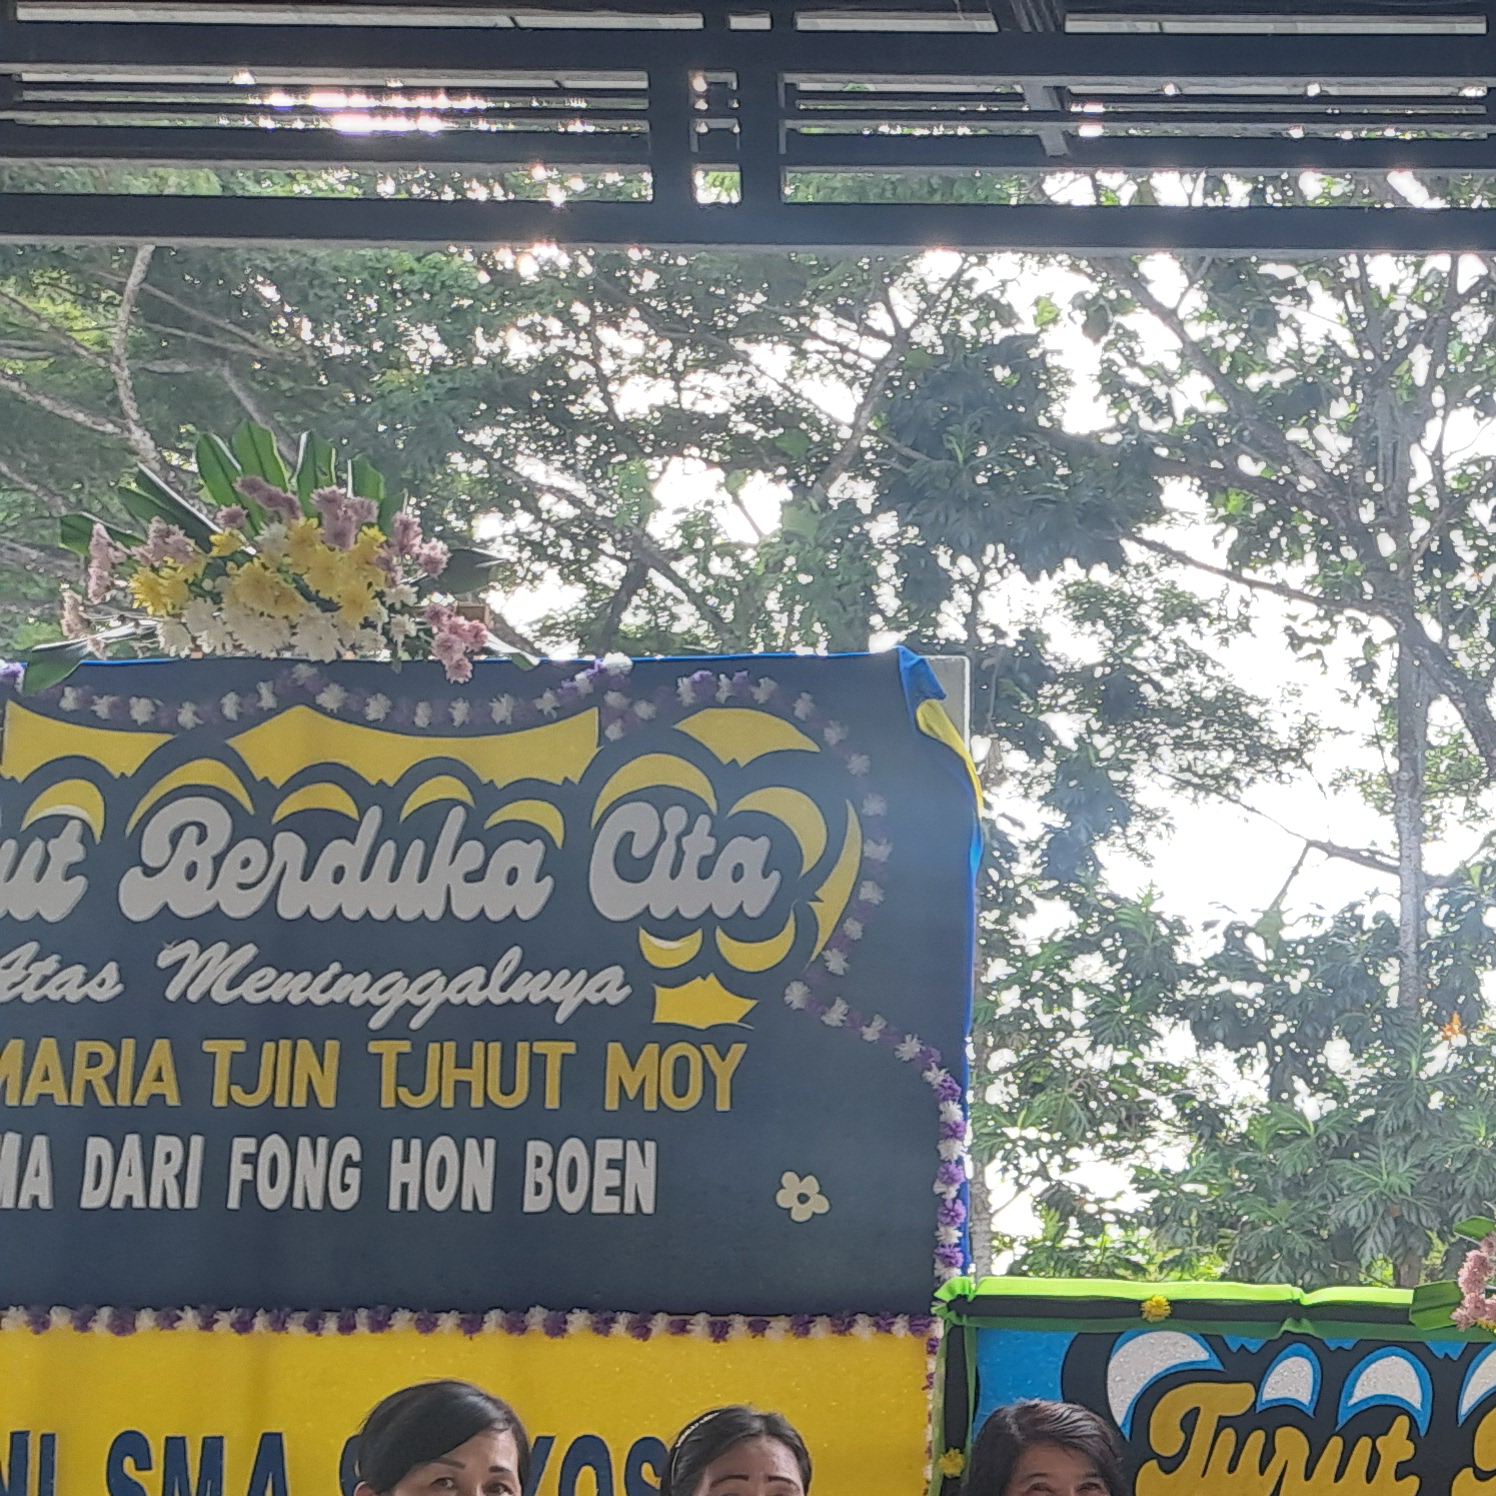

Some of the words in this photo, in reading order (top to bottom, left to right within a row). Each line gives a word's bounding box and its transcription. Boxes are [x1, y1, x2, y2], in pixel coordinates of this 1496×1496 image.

[118, 796, 554, 923] Berduka
[589, 802, 782, 922] Cita
[156, 939, 631, 1030] Meninggalnya
[202, 1038, 341, 1108] TJIN
[367, 1039, 577, 1111] TJHUT
[605, 1042, 748, 1112] MOY
[80, 1133, 204, 1210] DARI
[227, 1133, 362, 1211] FONG
[388, 1135, 497, 1212] HON
[522, 1138, 658, 1214] BOEN
